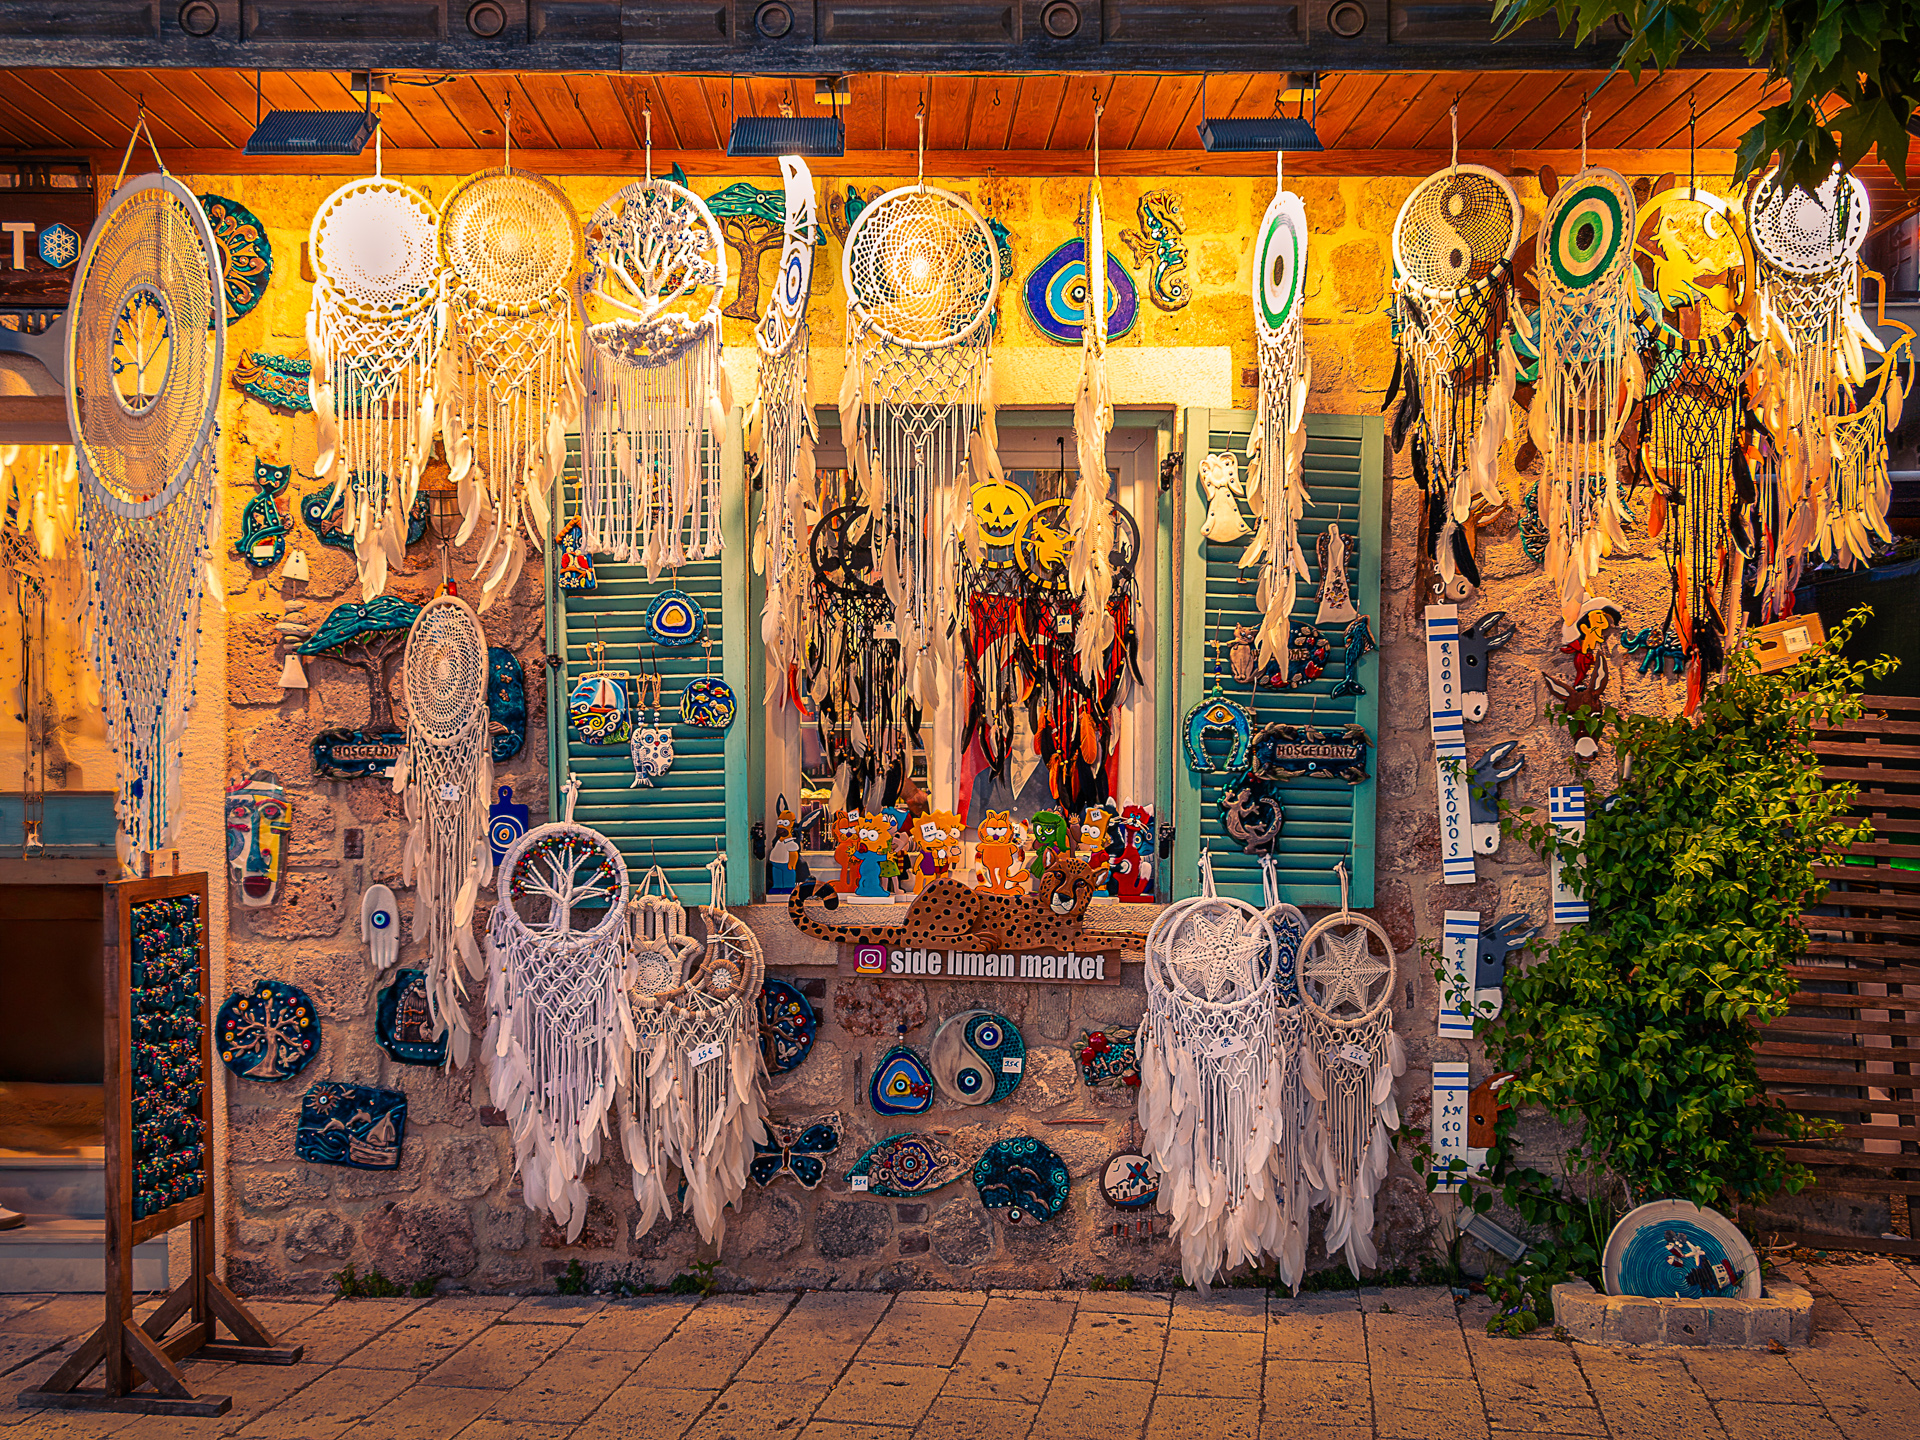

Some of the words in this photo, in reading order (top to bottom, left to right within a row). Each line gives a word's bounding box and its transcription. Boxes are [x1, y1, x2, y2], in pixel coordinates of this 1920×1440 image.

[0, 222, 36, 270] T
[890, 947, 942, 975] side
[946, 950, 1015, 978] liman
[1019, 952, 1106, 981] market
